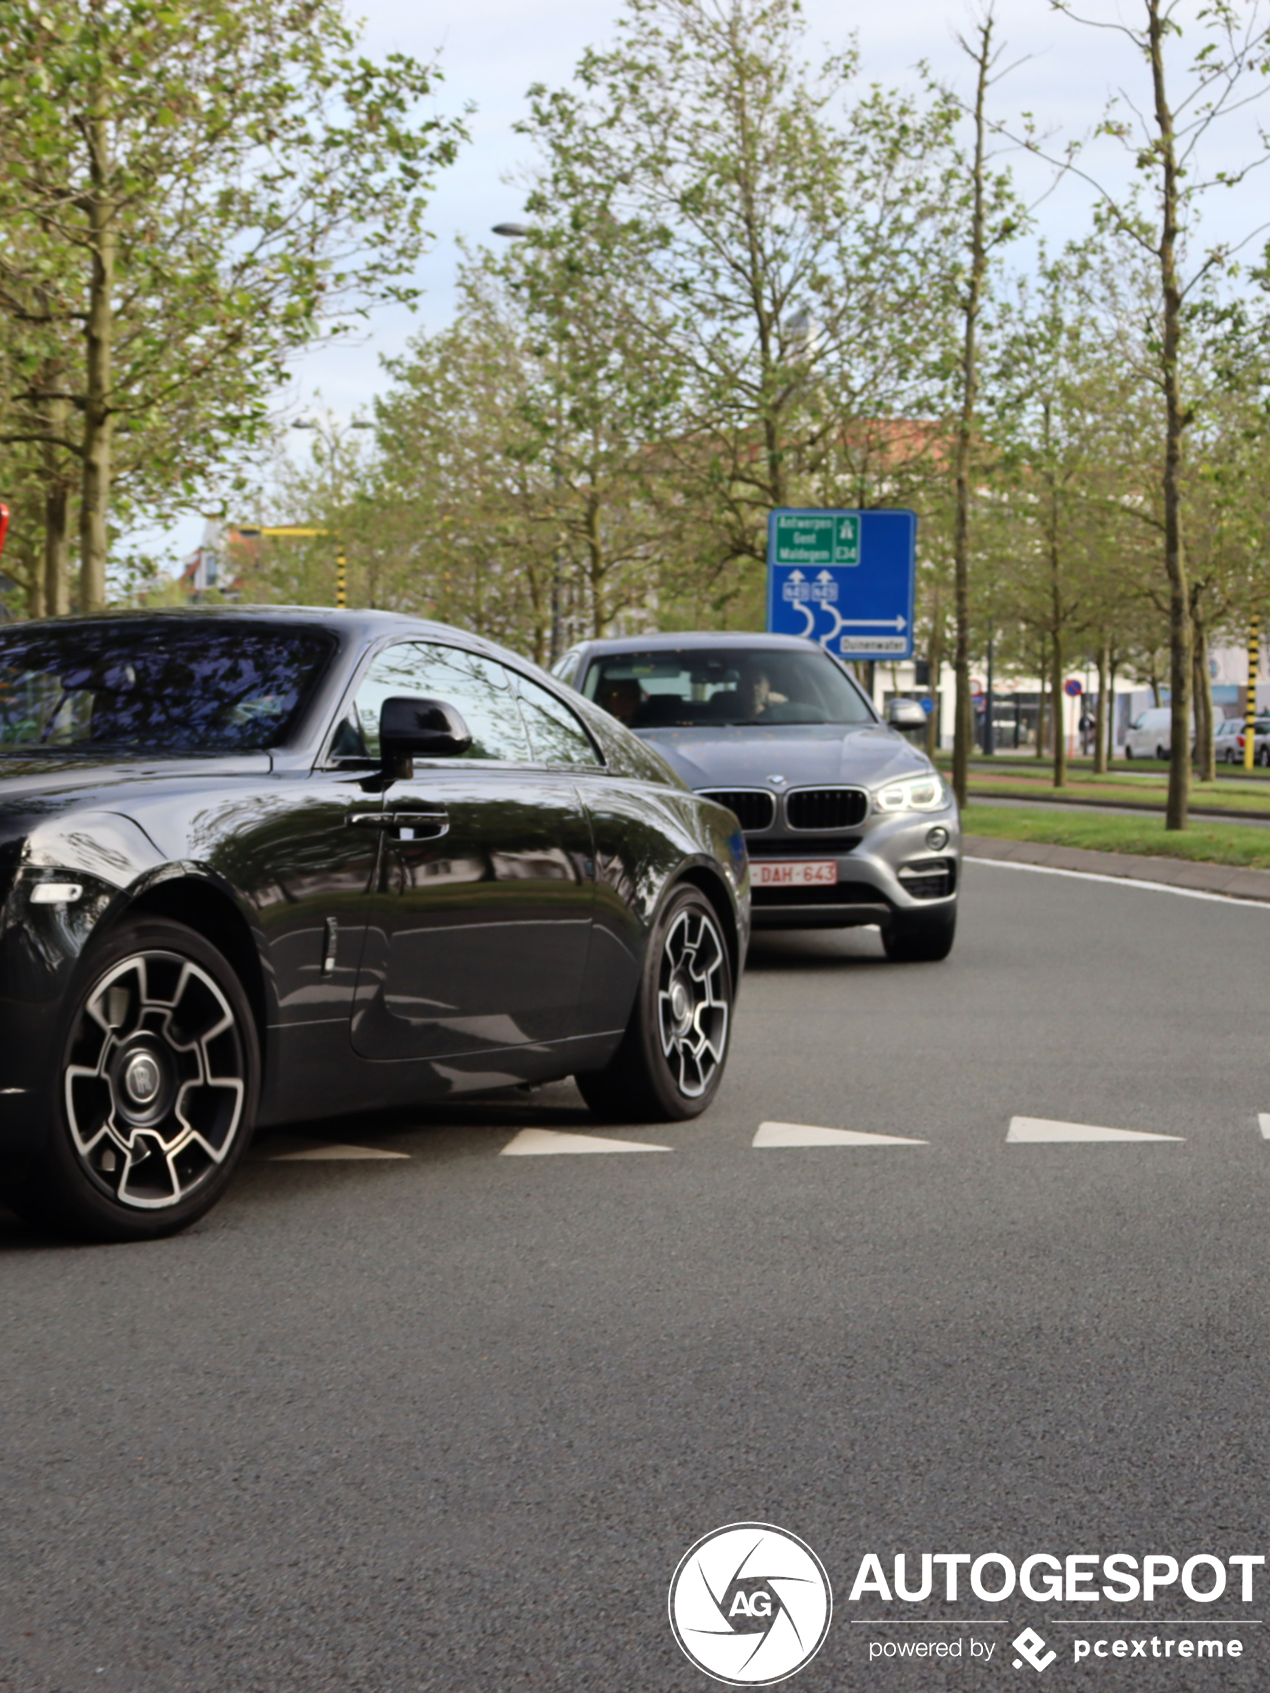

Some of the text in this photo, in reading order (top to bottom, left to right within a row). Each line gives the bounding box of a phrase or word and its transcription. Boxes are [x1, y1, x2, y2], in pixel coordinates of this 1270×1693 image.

[780, 516, 832, 530] Antwerpen
[793, 531, 817, 545] Gent
[779, 547, 830, 563] Maldegem
[835, 546, 858, 559] E34
[842, 638, 904, 651] Duinenwater
